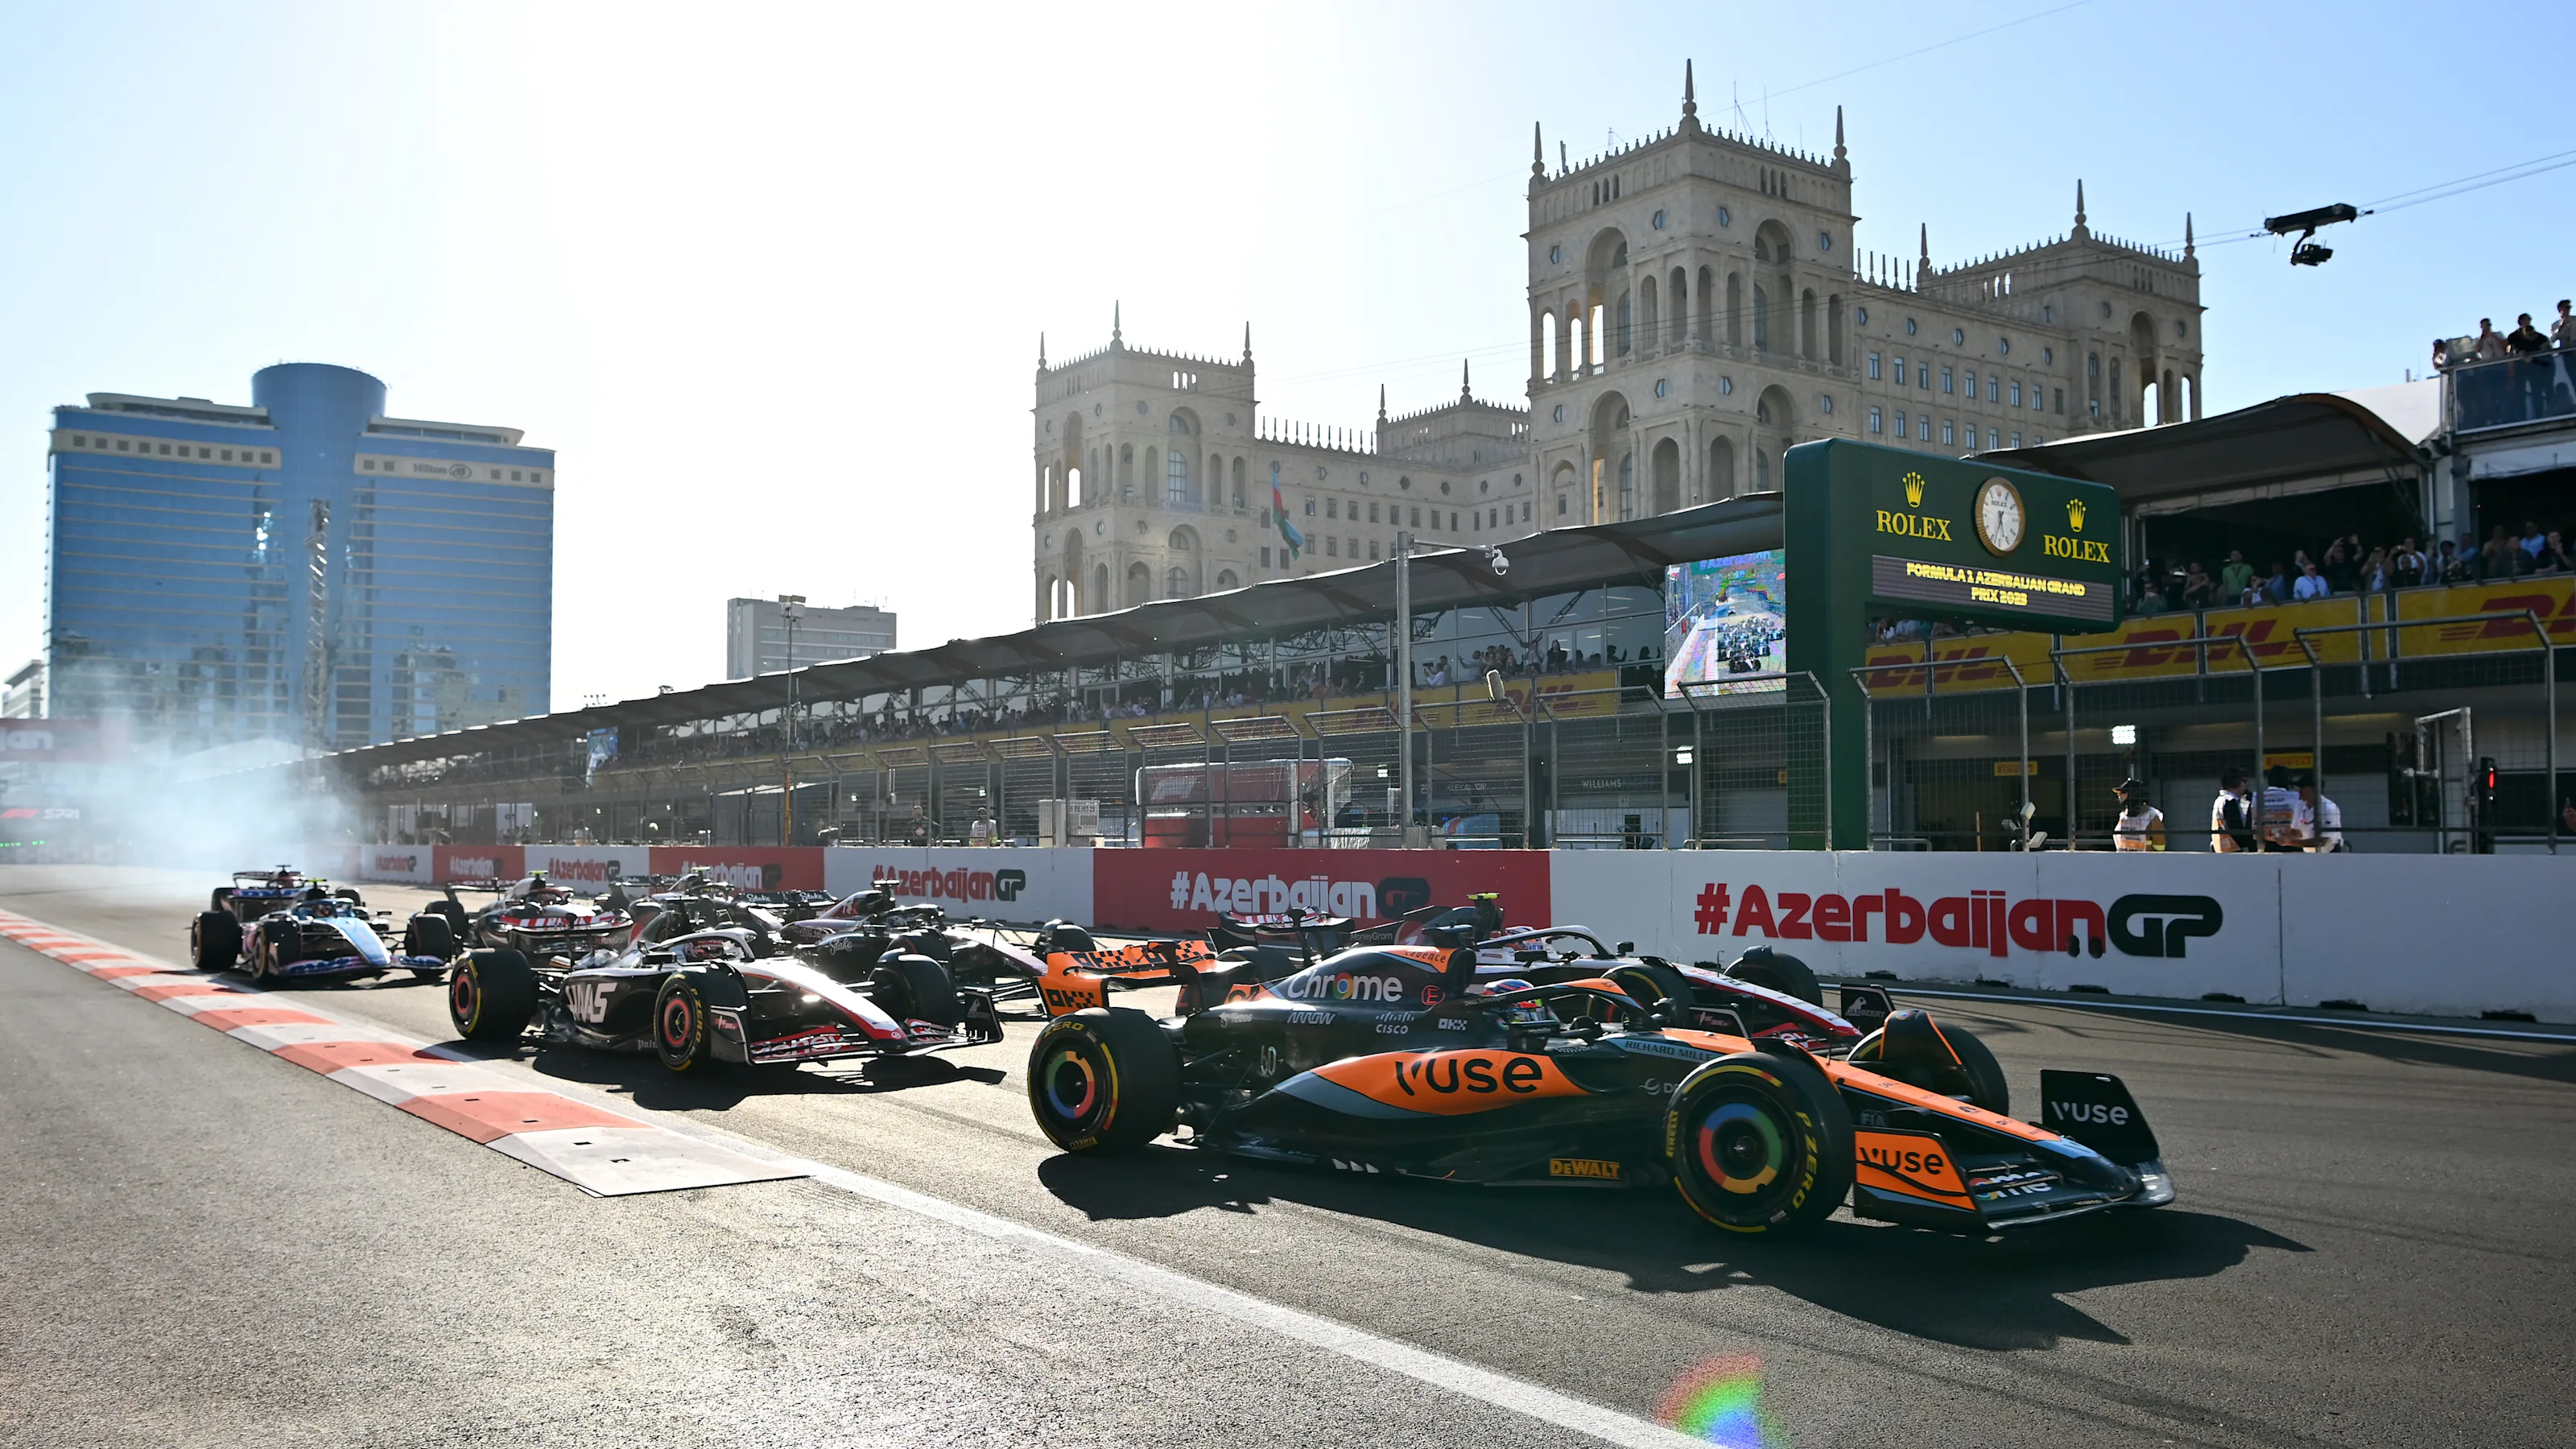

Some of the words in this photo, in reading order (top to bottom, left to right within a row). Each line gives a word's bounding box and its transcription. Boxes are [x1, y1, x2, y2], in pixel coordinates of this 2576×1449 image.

[413, 463, 448, 474] Hilton
[1876, 510, 1952, 542] ROLEX
[2043, 535, 2111, 564] ROLEX
[1906, 562, 1967, 583] FORMULA
[2047, 580, 2086, 597] GRAND
[1971, 586, 2000, 603] PRIX
[2000, 590, 2028, 606] 2023
[2121, 619, 2295, 668] DHL
[1865, 646, 1999, 688] DHL
[1582, 778, 1622, 789] WILLIAMS
[549, 858, 621, 884] #AzerbaijanGP
[873, 865, 1026, 903] #AzerbaijanGP
[745, 894, 771, 903] Stake
[799, 890, 823, 902] Stake
[1170, 871, 1431, 919] #AzerbaijanGP
[1694, 883, 2223, 958] #AzerbaijanGP
[829, 937, 853, 956] Stake
[1350, 931, 1393, 947] MoneyGram
[1287, 969, 1403, 1002] Chrome
[1625, 1040, 1674, 1055] RICHARD
[1678, 1049, 1715, 1063] MILLE
[1795, 1112, 1813, 1129] P
[1792, 1133, 1818, 1209] ZERO
